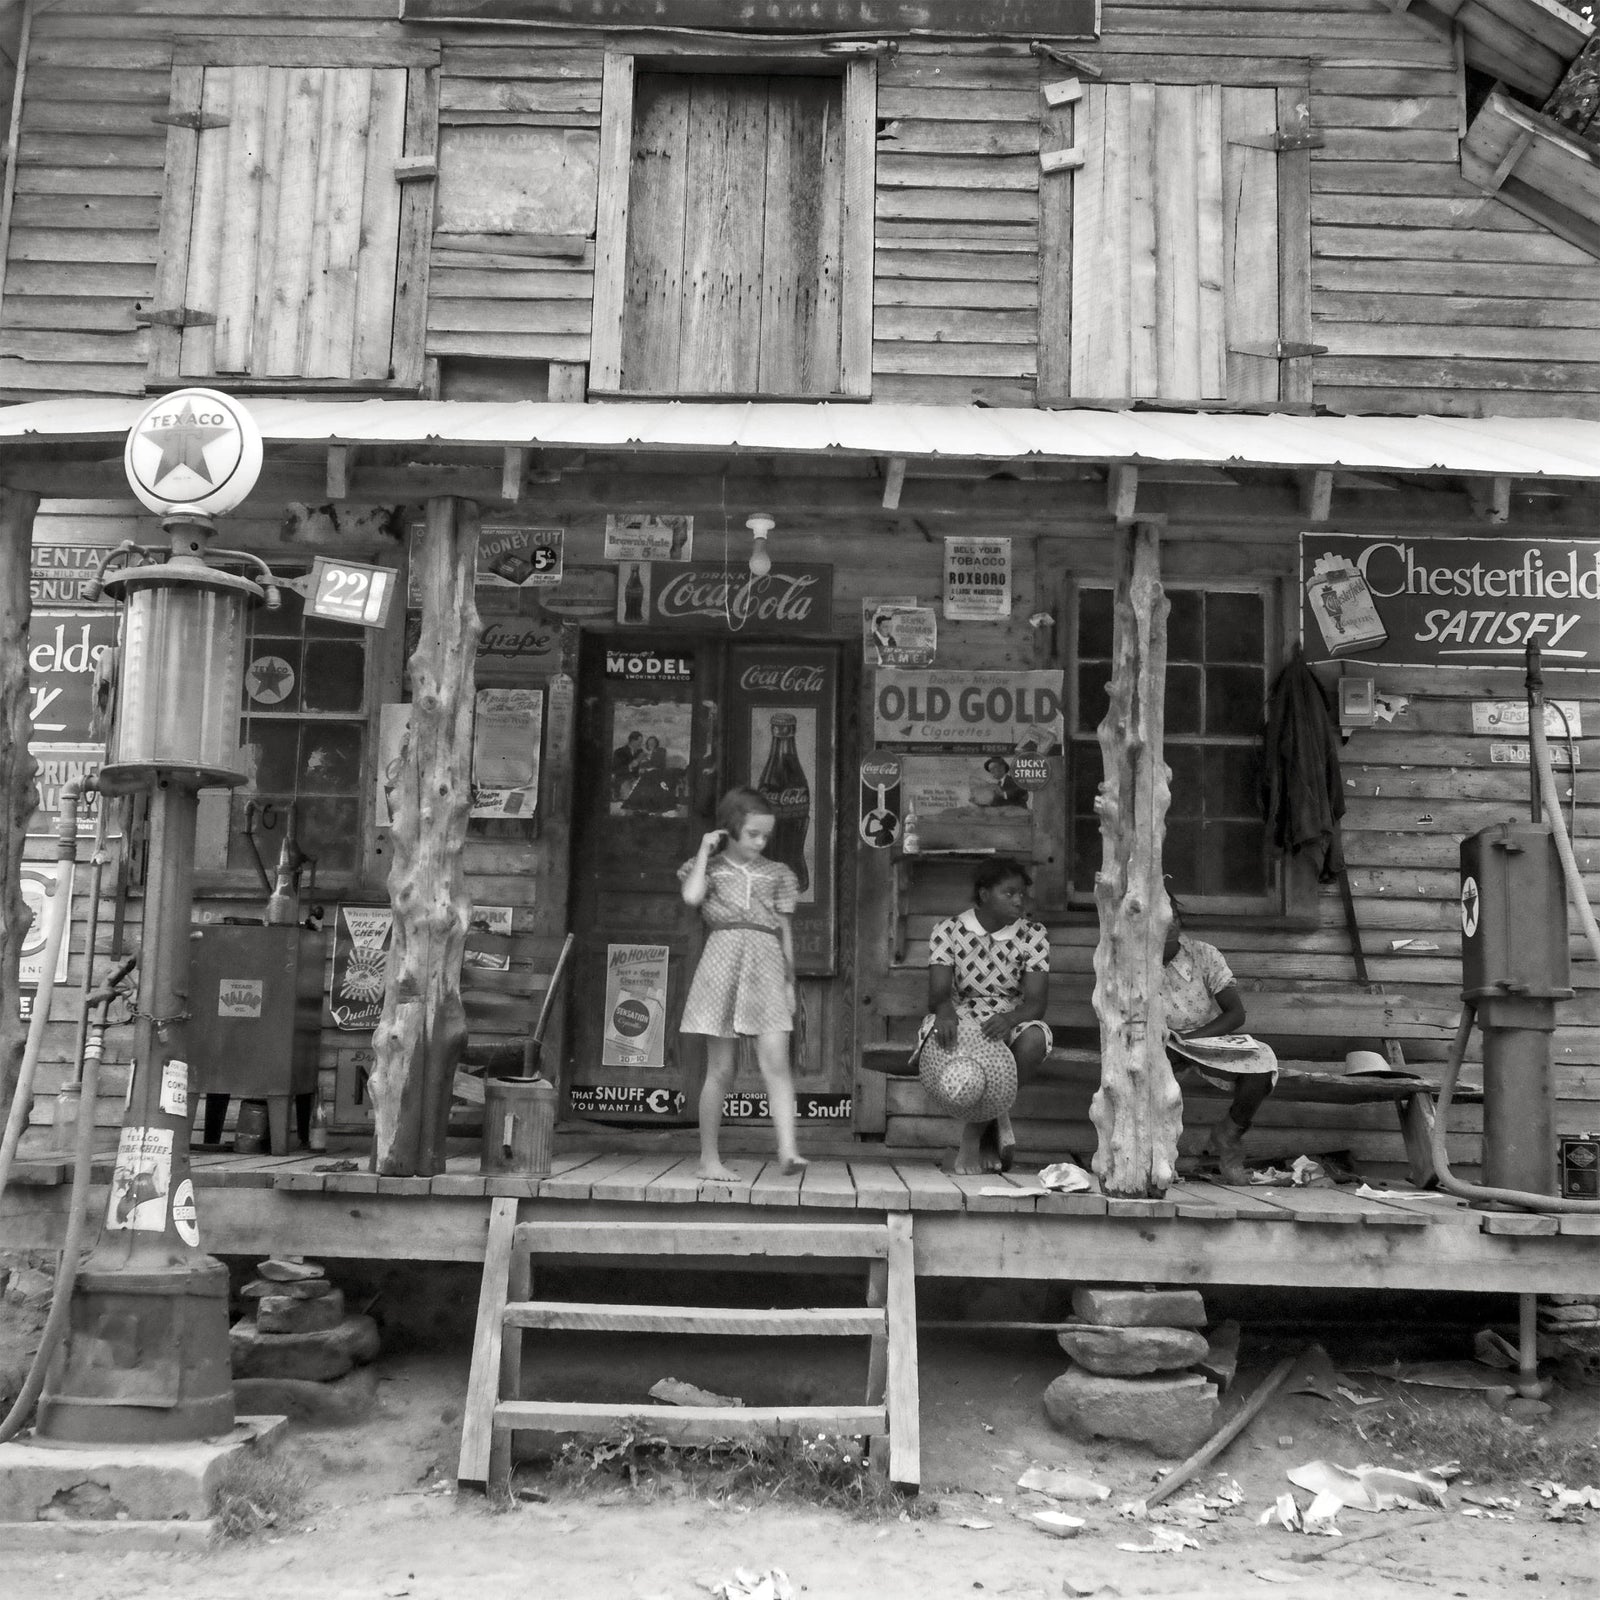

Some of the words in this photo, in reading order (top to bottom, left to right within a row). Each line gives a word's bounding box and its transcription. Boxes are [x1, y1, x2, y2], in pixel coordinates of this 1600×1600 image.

[151, 413, 224, 428] TEXACO
[479, 533, 529, 559] HONEY
[533, 532, 560, 546] CUT
[978, 546, 1002, 554] YOUR
[31, 548, 109, 568] ENTA
[950, 556, 1006, 566] TOBACCO
[949, 571, 1006, 586] ROXBORO
[1356, 542, 1600, 600] Chesterfield
[322, 569, 369, 607] 22
[657, 571, 819, 620] Coca-Cola
[479, 623, 551, 650] Grape
[1414, 608, 1581, 648] SATISFY
[29, 624, 99, 673] elds
[606, 657, 691, 674] MODEL
[739, 664, 827, 691] Coca-Cola
[878, 685, 951, 721] OLD
[958, 686, 1058, 724] GOLD
[921, 725, 992, 739] Cigarettes
[863, 762, 898, 775] Coca-Cola
[1016, 759, 1045, 768] LUCKY
[1014, 769, 1047, 778] STRIKE
[371, 910, 391, 918] tired
[350, 920, 376, 928] TAKE
[354, 929, 384, 937] CHEW
[363, 939, 373, 948] of
[609, 950, 628, 968] NO
[627, 948, 666, 961] HOKUM
[335, 1004, 383, 1026] Quality
[616, 1006, 649, 1023] SENSATION
[571, 1090, 594, 1099] THAT
[595, 1086, 645, 1101] SNUFF
[571, 1102, 594, 1111] YOU
[598, 1103, 630, 1112] WANT
[634, 1104, 644, 1112] IS
[722, 1101, 752, 1117] RED
[808, 1099, 851, 1117] Snuff
